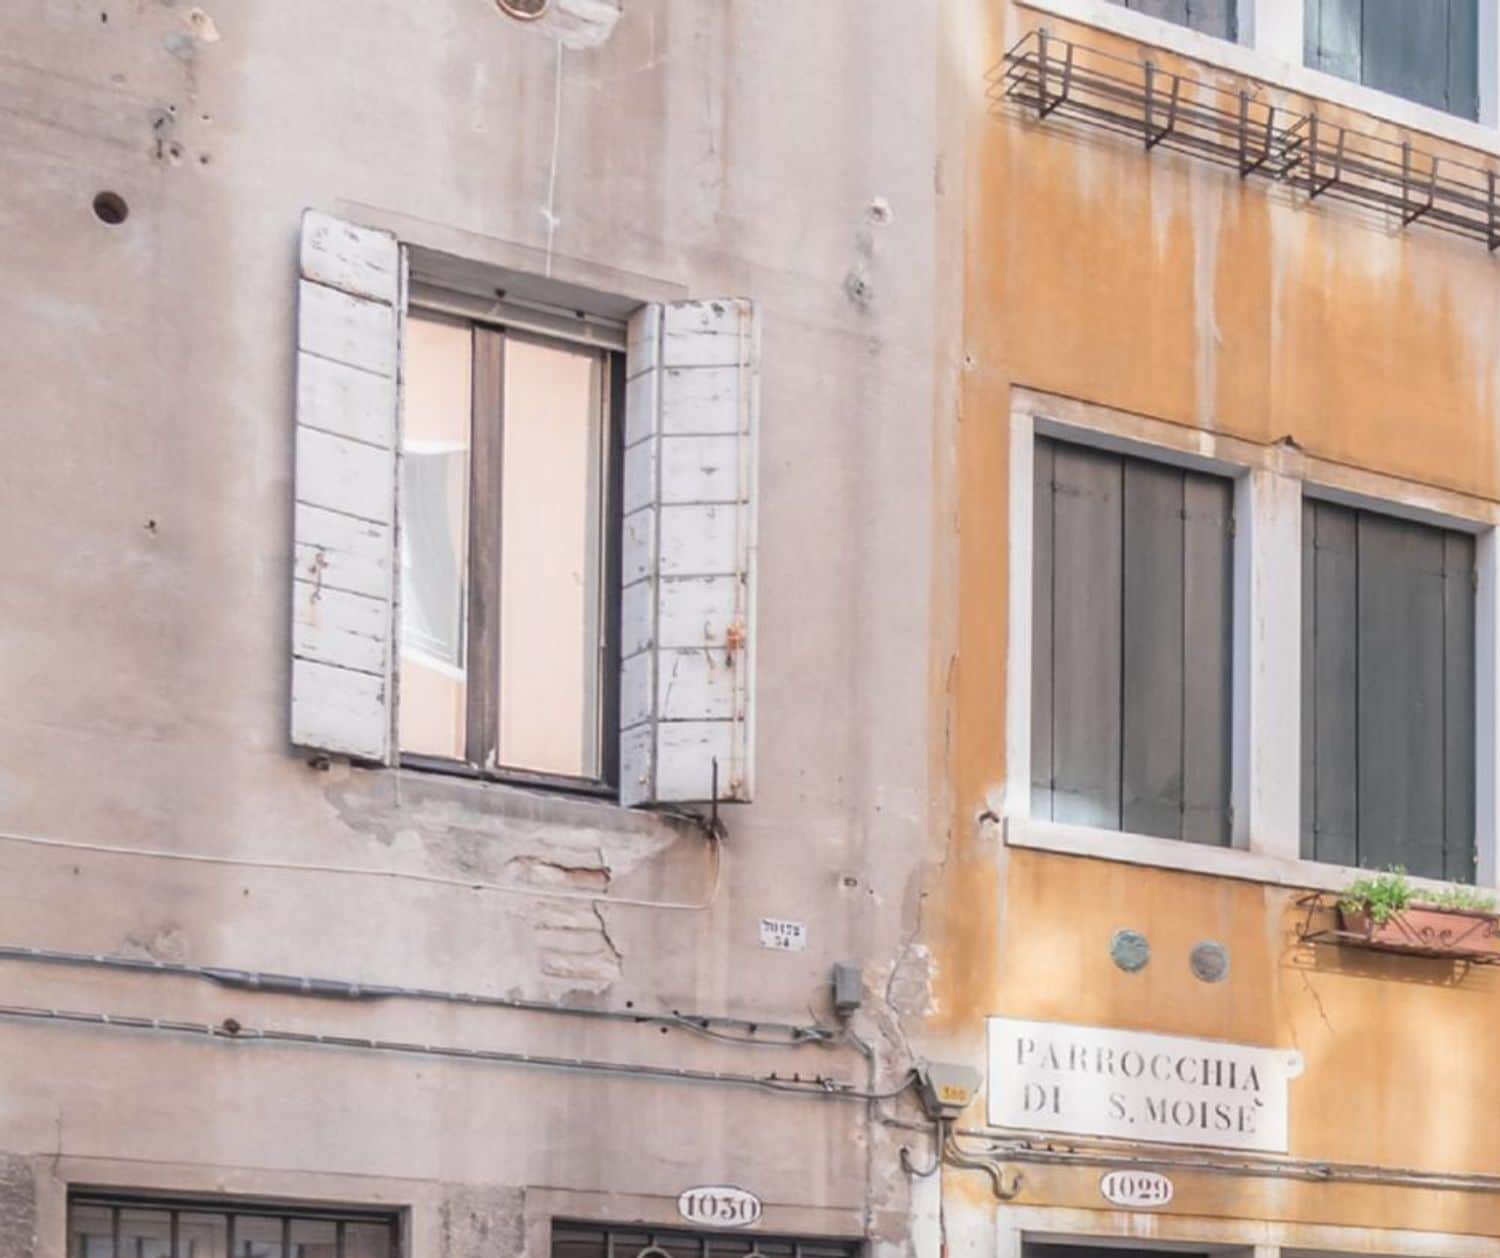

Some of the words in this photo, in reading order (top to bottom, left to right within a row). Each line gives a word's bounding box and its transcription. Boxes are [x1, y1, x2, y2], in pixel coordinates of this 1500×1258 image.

[1017, 1038, 1260, 1092] PARROCCHIA
[1023, 1083, 1060, 1114] DI
[1109, 1176, 1169, 1199] 1029
[687, 1194, 757, 1220] 1030
